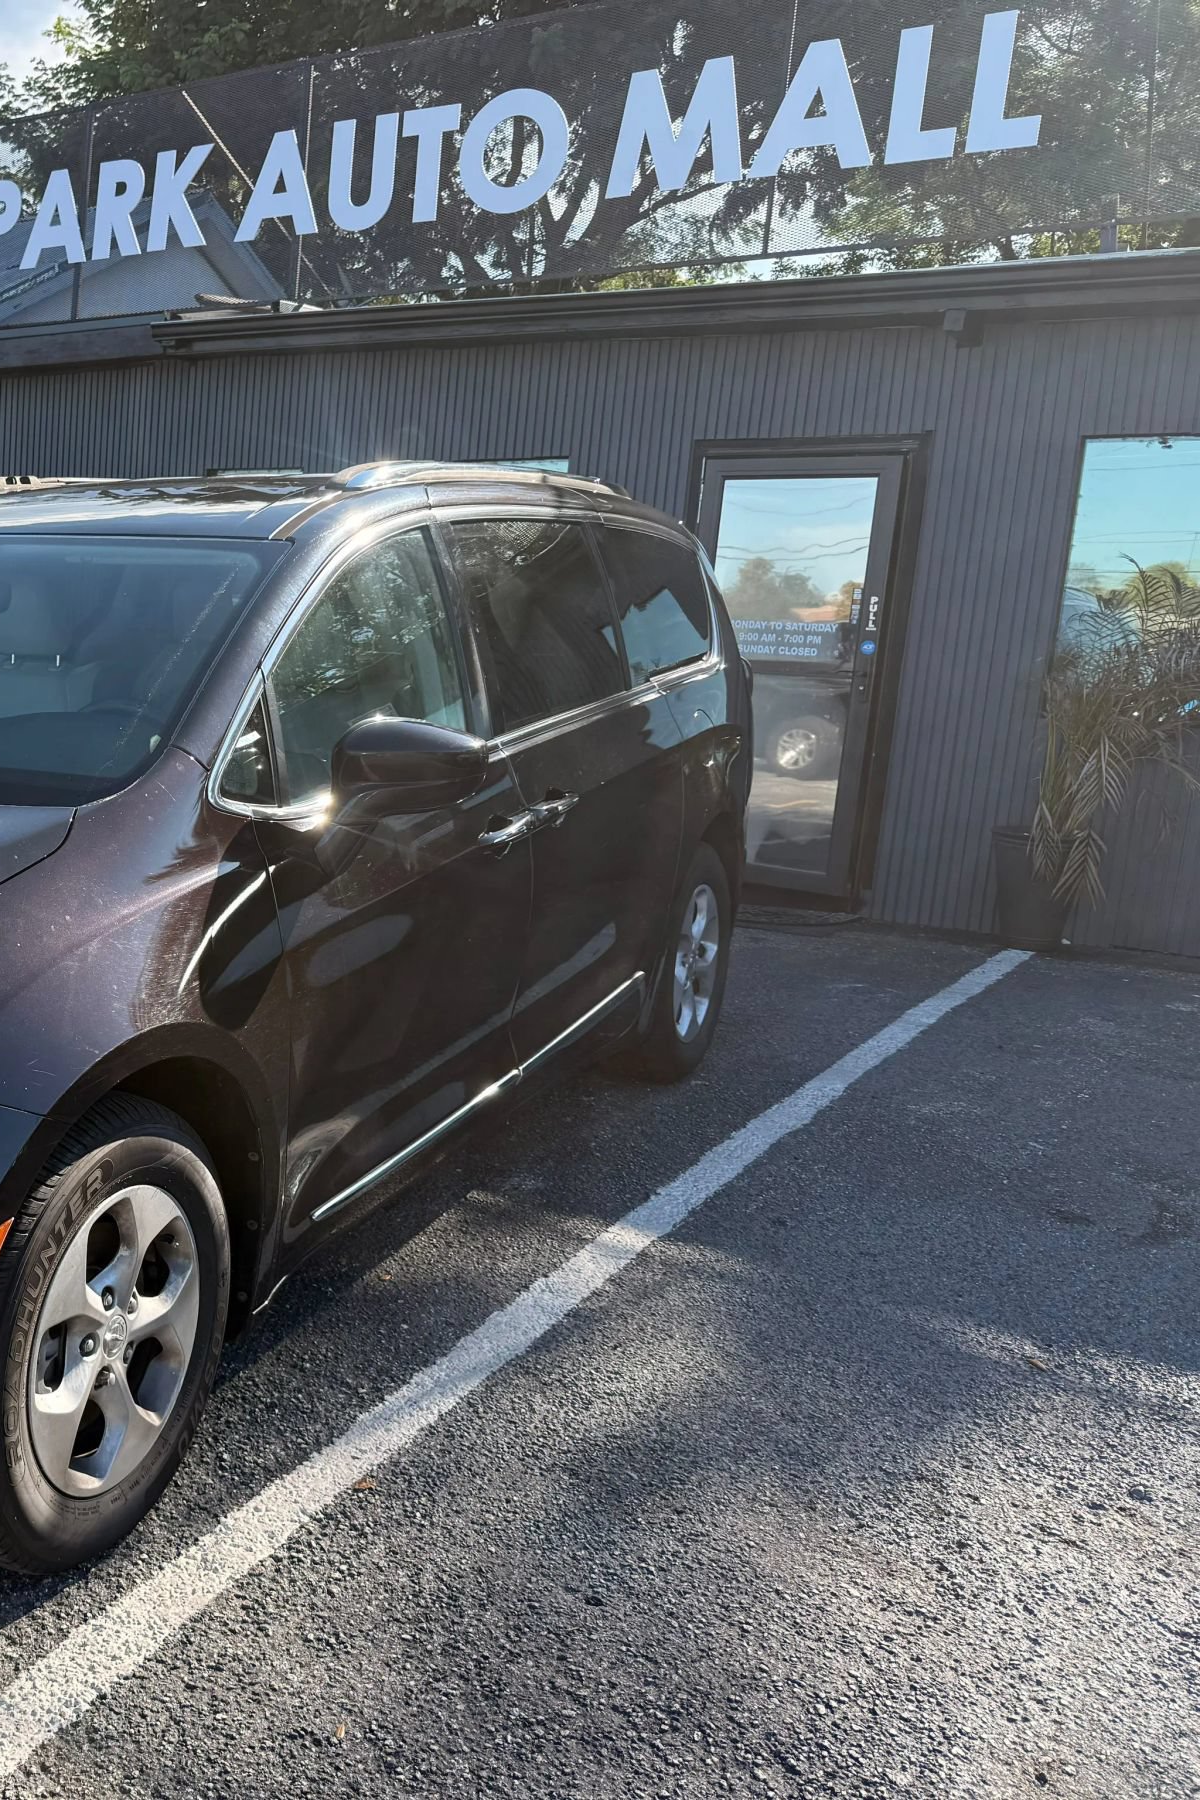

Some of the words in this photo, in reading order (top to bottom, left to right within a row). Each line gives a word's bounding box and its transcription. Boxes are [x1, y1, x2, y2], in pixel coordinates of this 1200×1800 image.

[234, 88, 569, 243] AUTO
[606, 9, 1043, 200] MALL
[868, 596, 879, 628] PULL
[770, 621, 783, 630] TO
[785, 622, 839, 633] SATURDAY
[760, 633, 776, 642] AM
[783, 634, 805, 643] 7:00
[806, 635, 822, 645] PM
[778, 646, 818, 657] CLOSED
